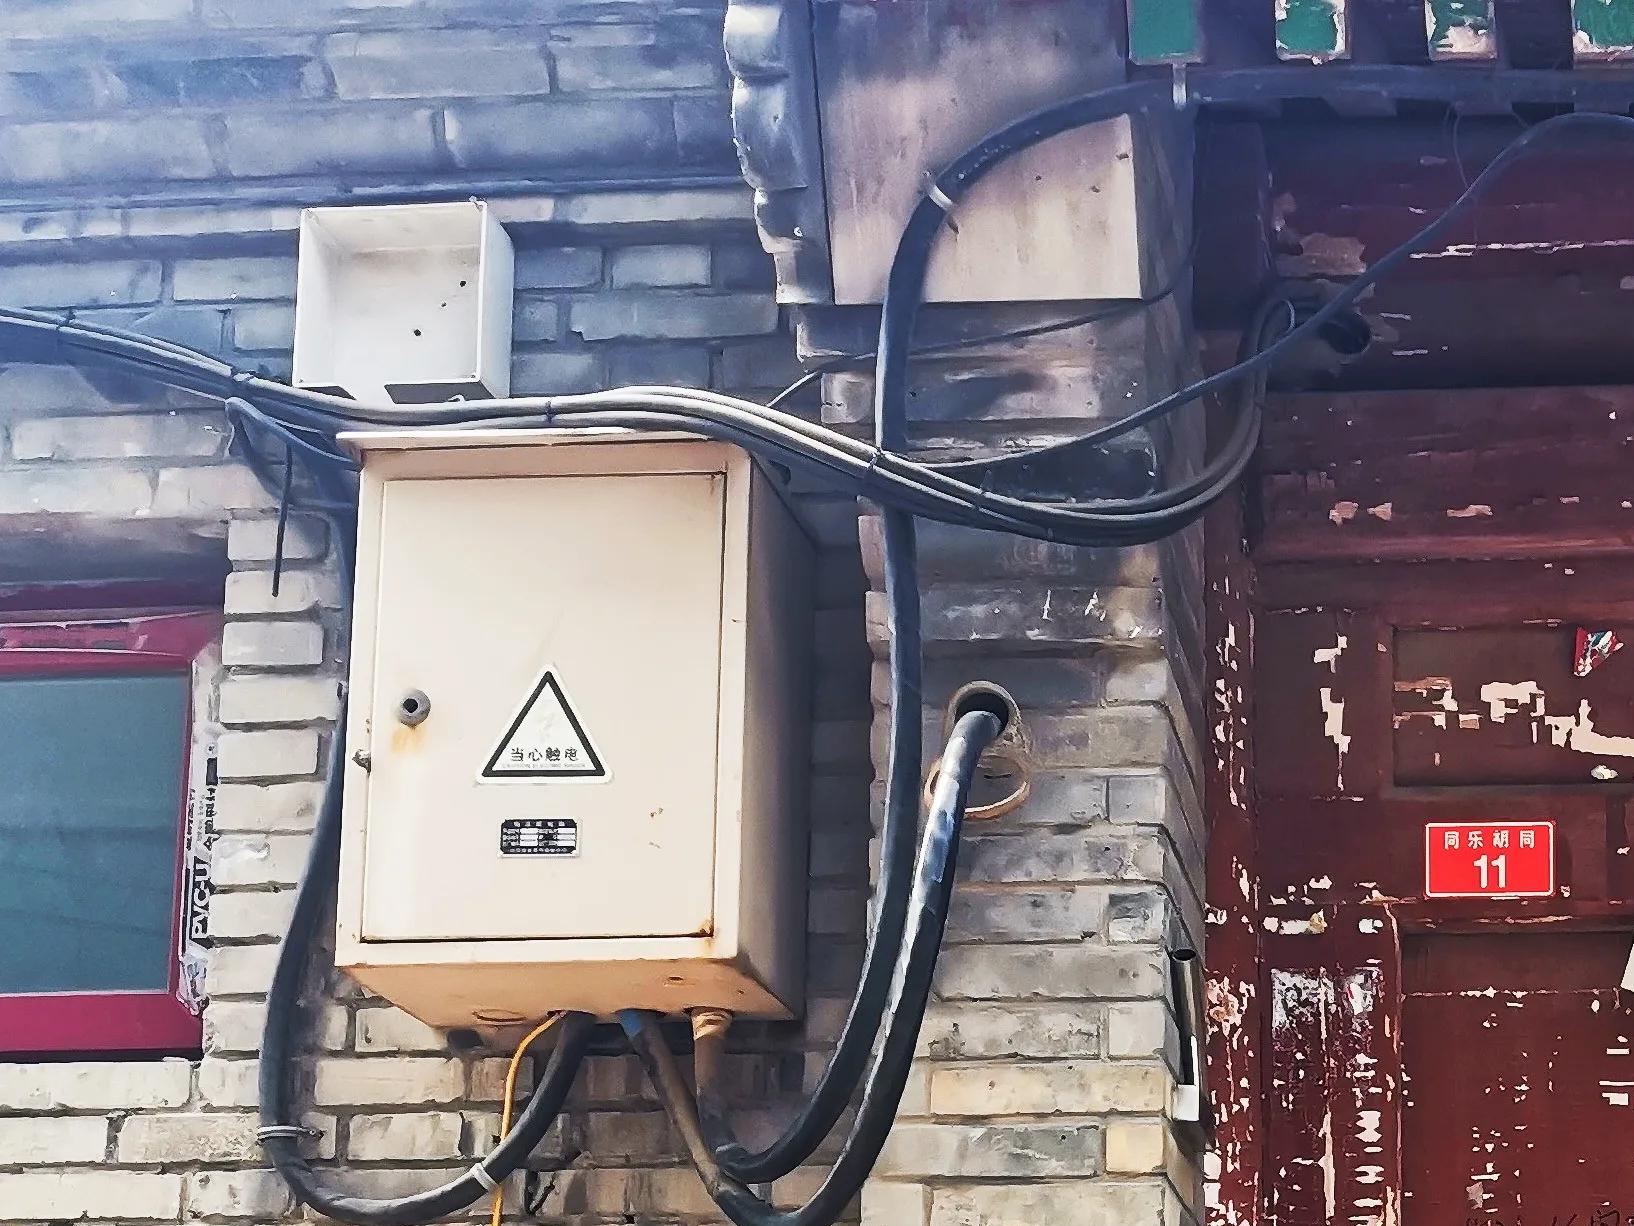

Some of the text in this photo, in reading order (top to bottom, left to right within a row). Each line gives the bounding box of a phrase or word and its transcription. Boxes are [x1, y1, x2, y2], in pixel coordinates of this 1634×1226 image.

[1443, 830, 1536, 850] 同乐胡同
[1473, 855, 1507, 888] 11
